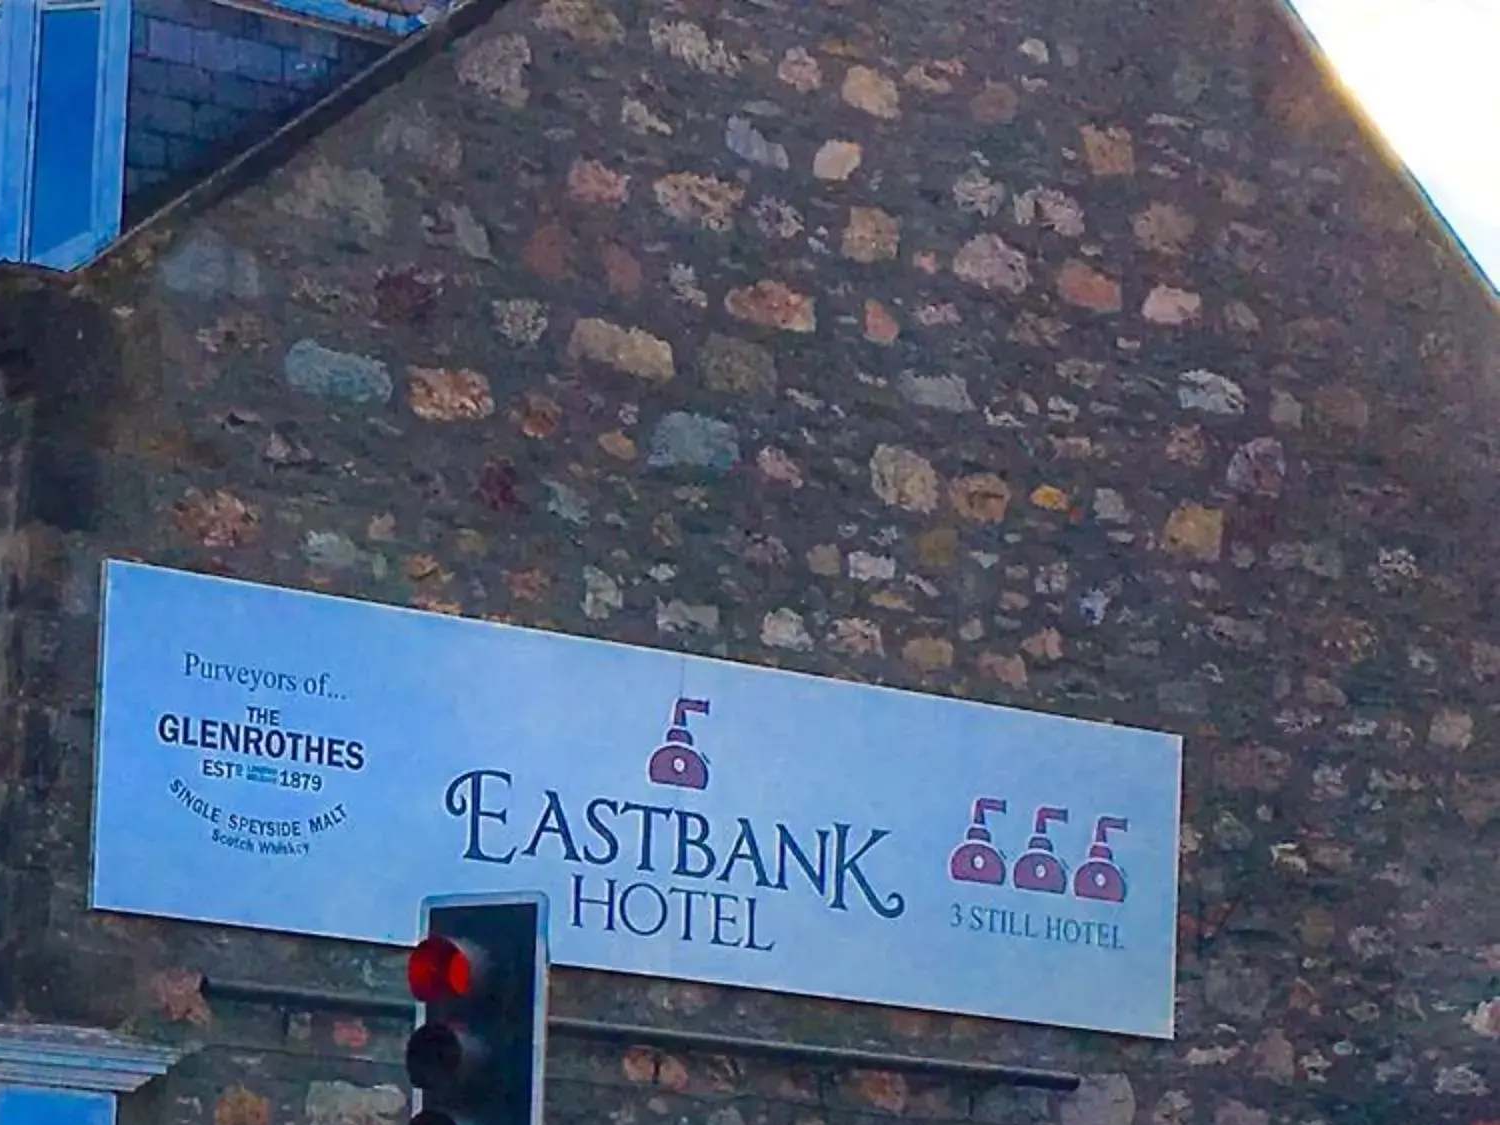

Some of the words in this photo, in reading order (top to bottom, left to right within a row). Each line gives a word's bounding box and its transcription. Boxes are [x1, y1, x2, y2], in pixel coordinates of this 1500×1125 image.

[184, 651, 297, 692] Purveyors
[304, 672, 347, 700] of...
[158, 713, 364, 770] GLENROTHES
[247, 706, 280, 726] THE
[280, 769, 322, 791] 1879
[169, 778, 221, 824] SINGLE
[228, 813, 301, 837] SPEYSIDE
[308, 803, 347, 833] MALT
[445, 769, 905, 919] EASTBANK
[571, 874, 776, 952] HOTEL
[950, 902, 962, 928] 3
[969, 905, 1039, 938] STILL
[1045, 915, 1125, 950] HOTEL
